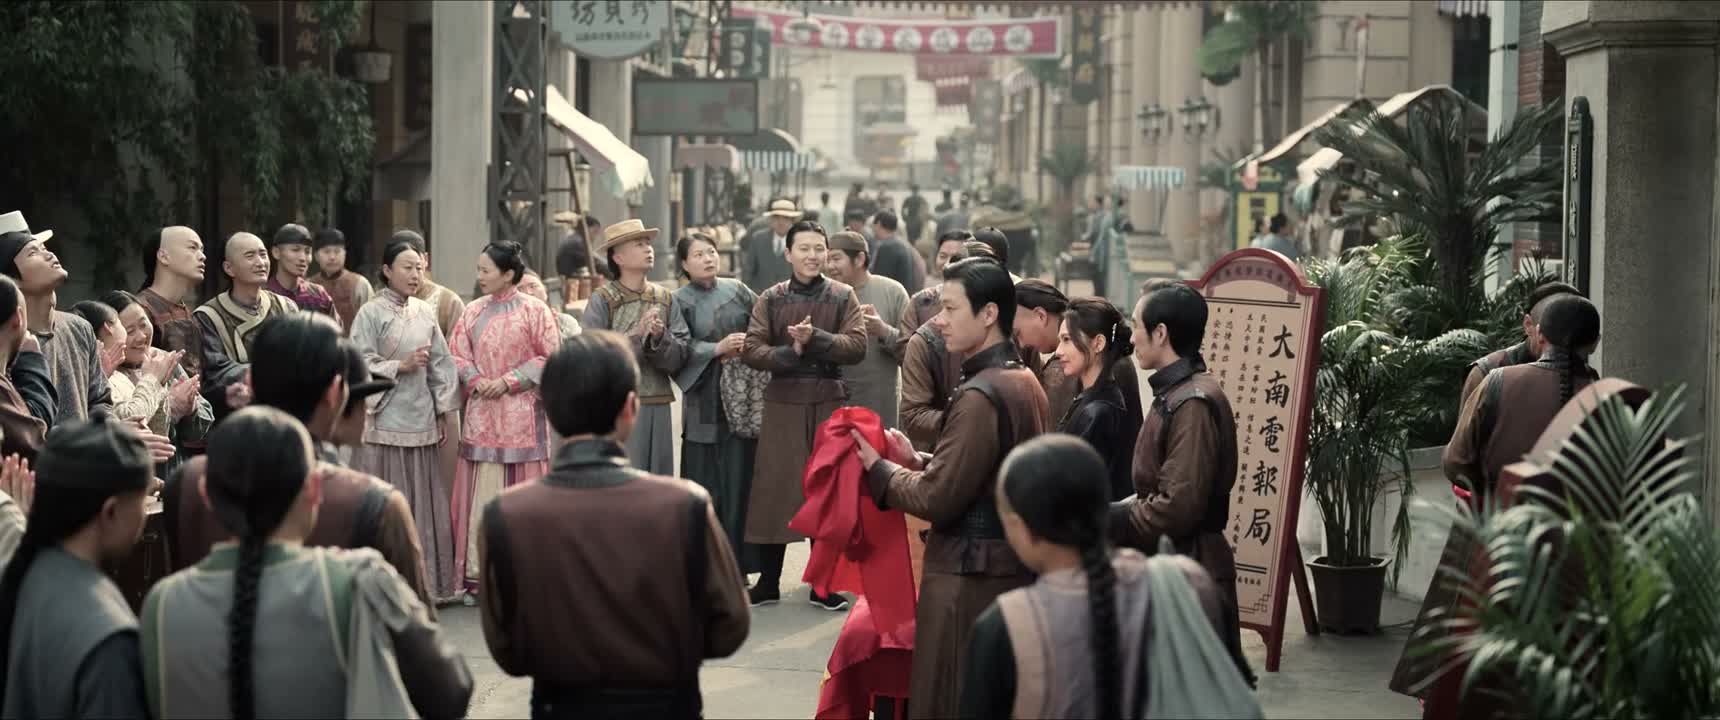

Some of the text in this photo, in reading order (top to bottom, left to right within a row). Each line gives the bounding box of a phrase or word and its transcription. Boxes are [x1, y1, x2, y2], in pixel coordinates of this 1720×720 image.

[1244, 323, 1295, 547] 大南電報局
